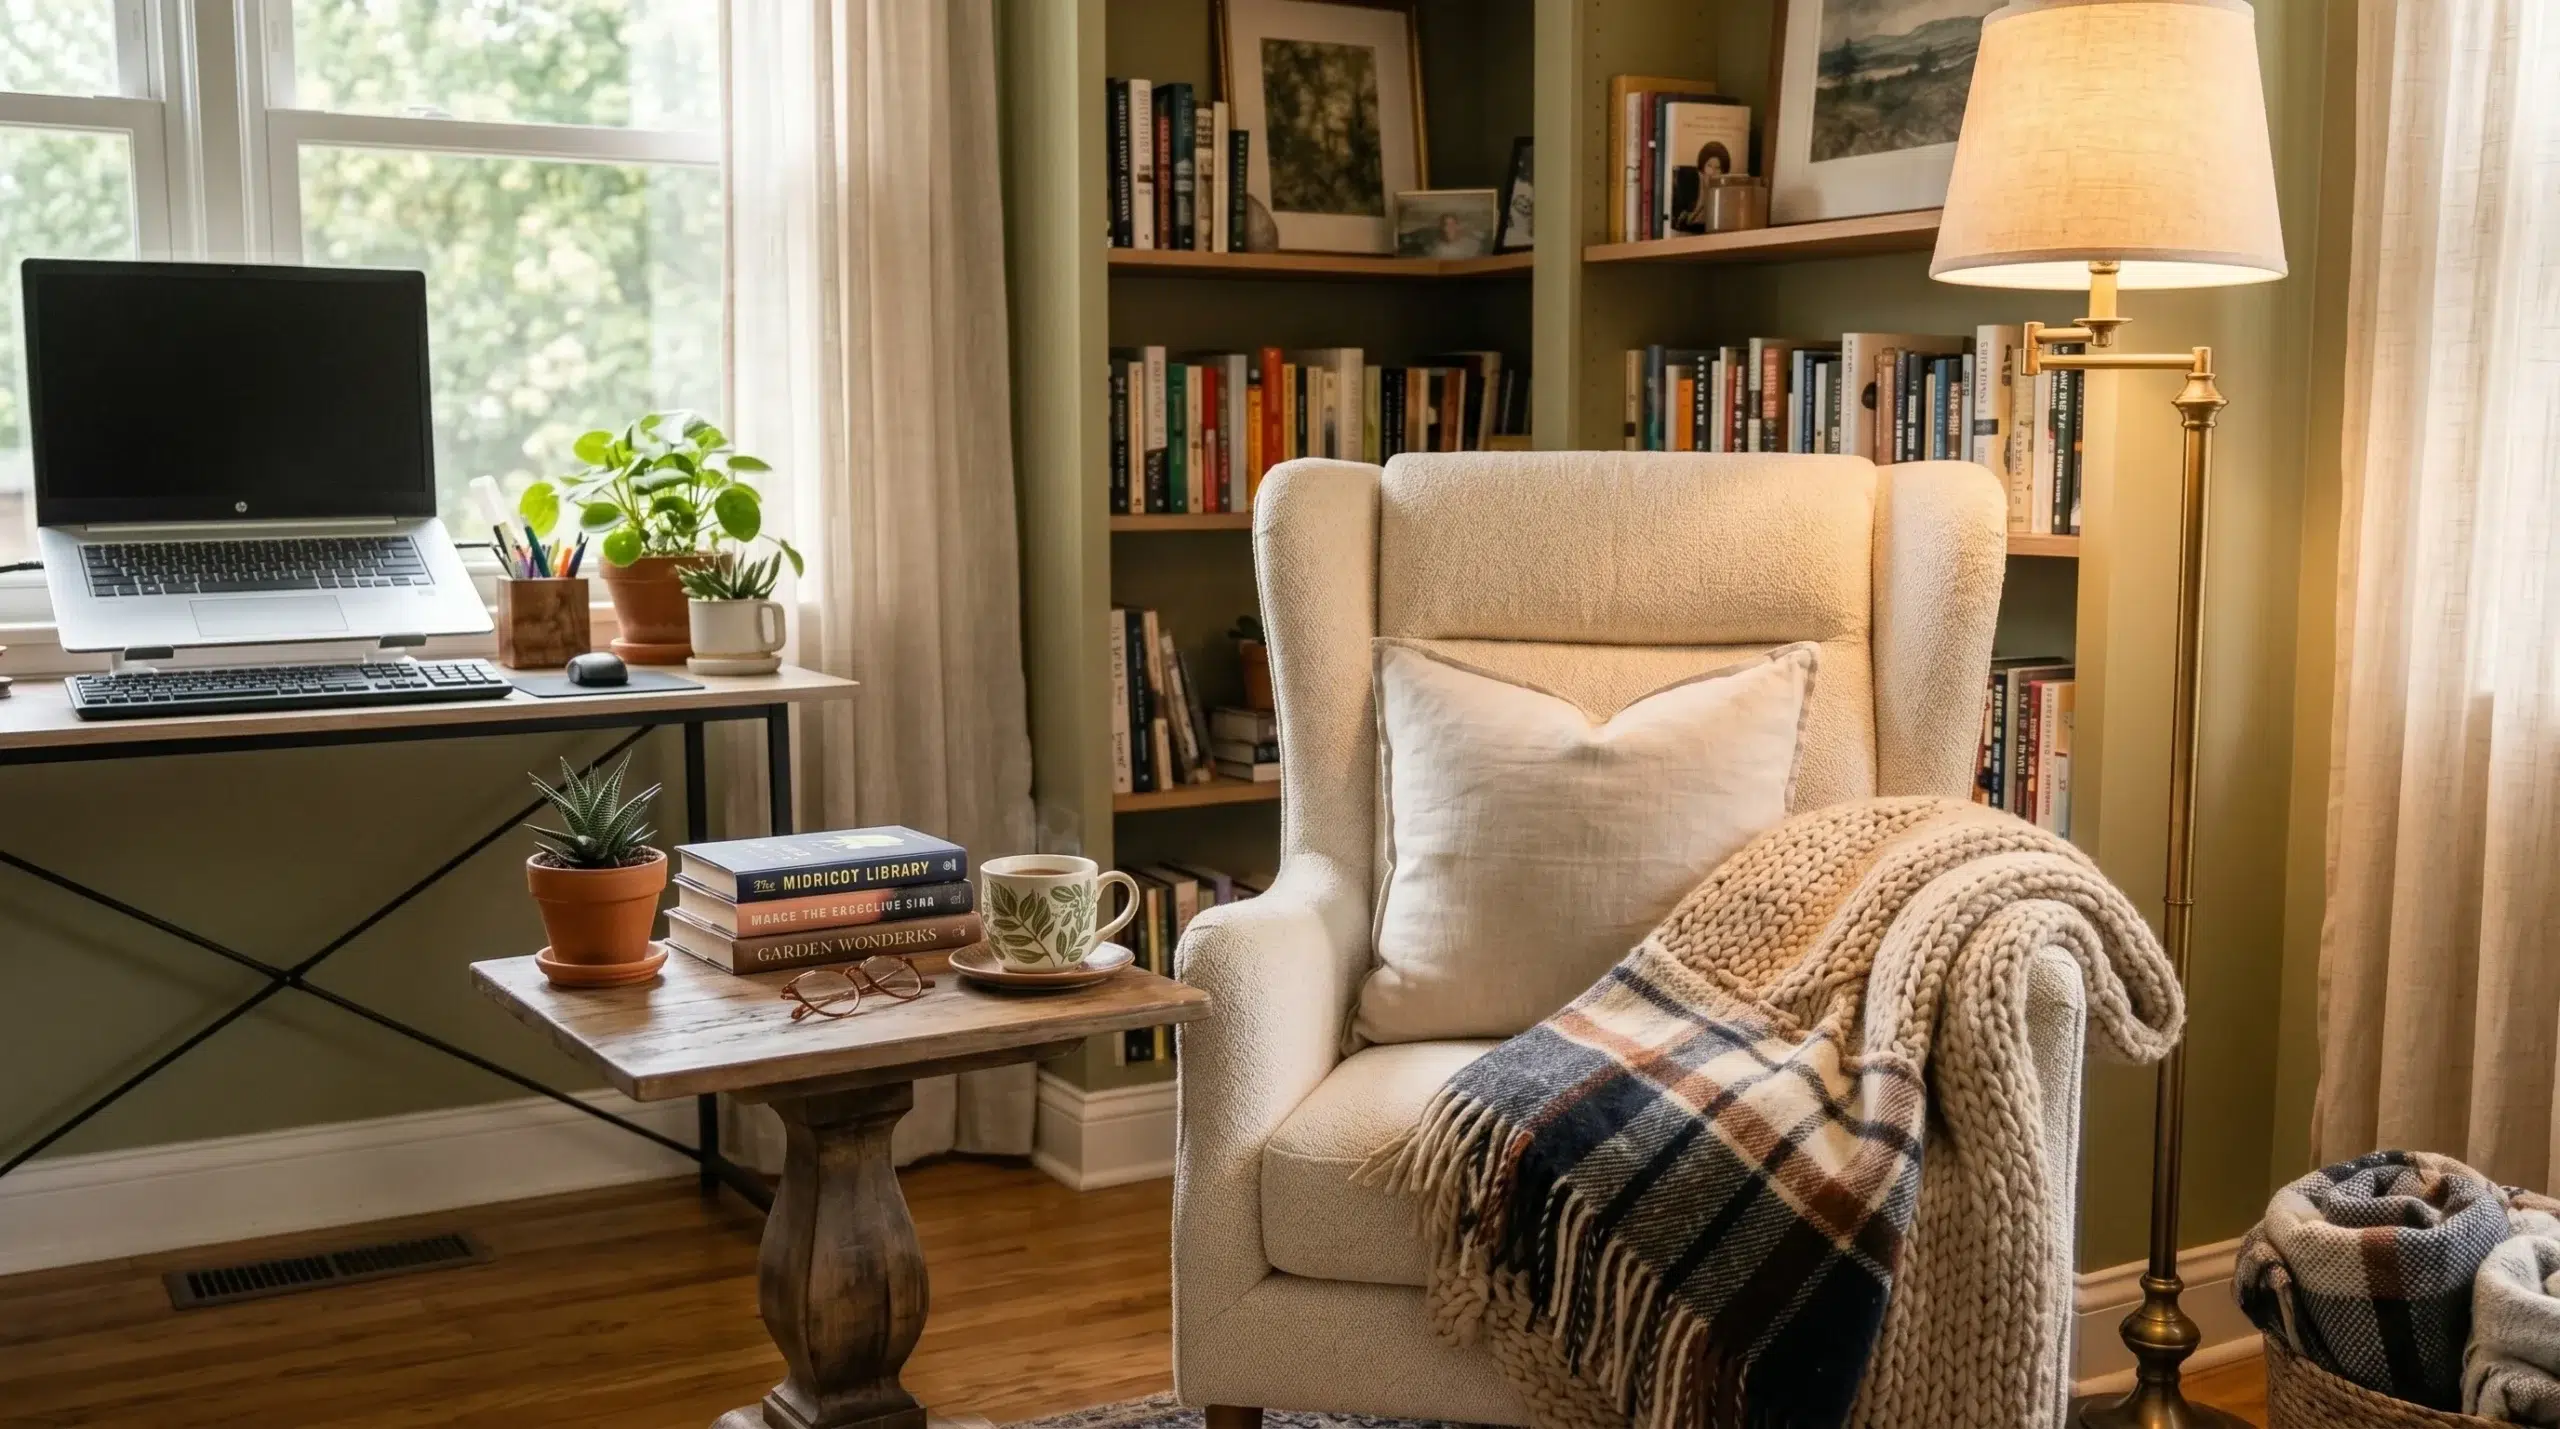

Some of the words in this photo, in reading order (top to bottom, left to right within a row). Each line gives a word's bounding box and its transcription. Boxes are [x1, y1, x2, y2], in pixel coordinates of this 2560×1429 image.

[783, 868, 860, 891] MIDRICOT
[866, 861, 930, 881] LIBRARY
[802, 907, 827, 920] THE
[757, 940, 832, 962] GARDEN
[838, 928, 937, 952] WONDERKS
